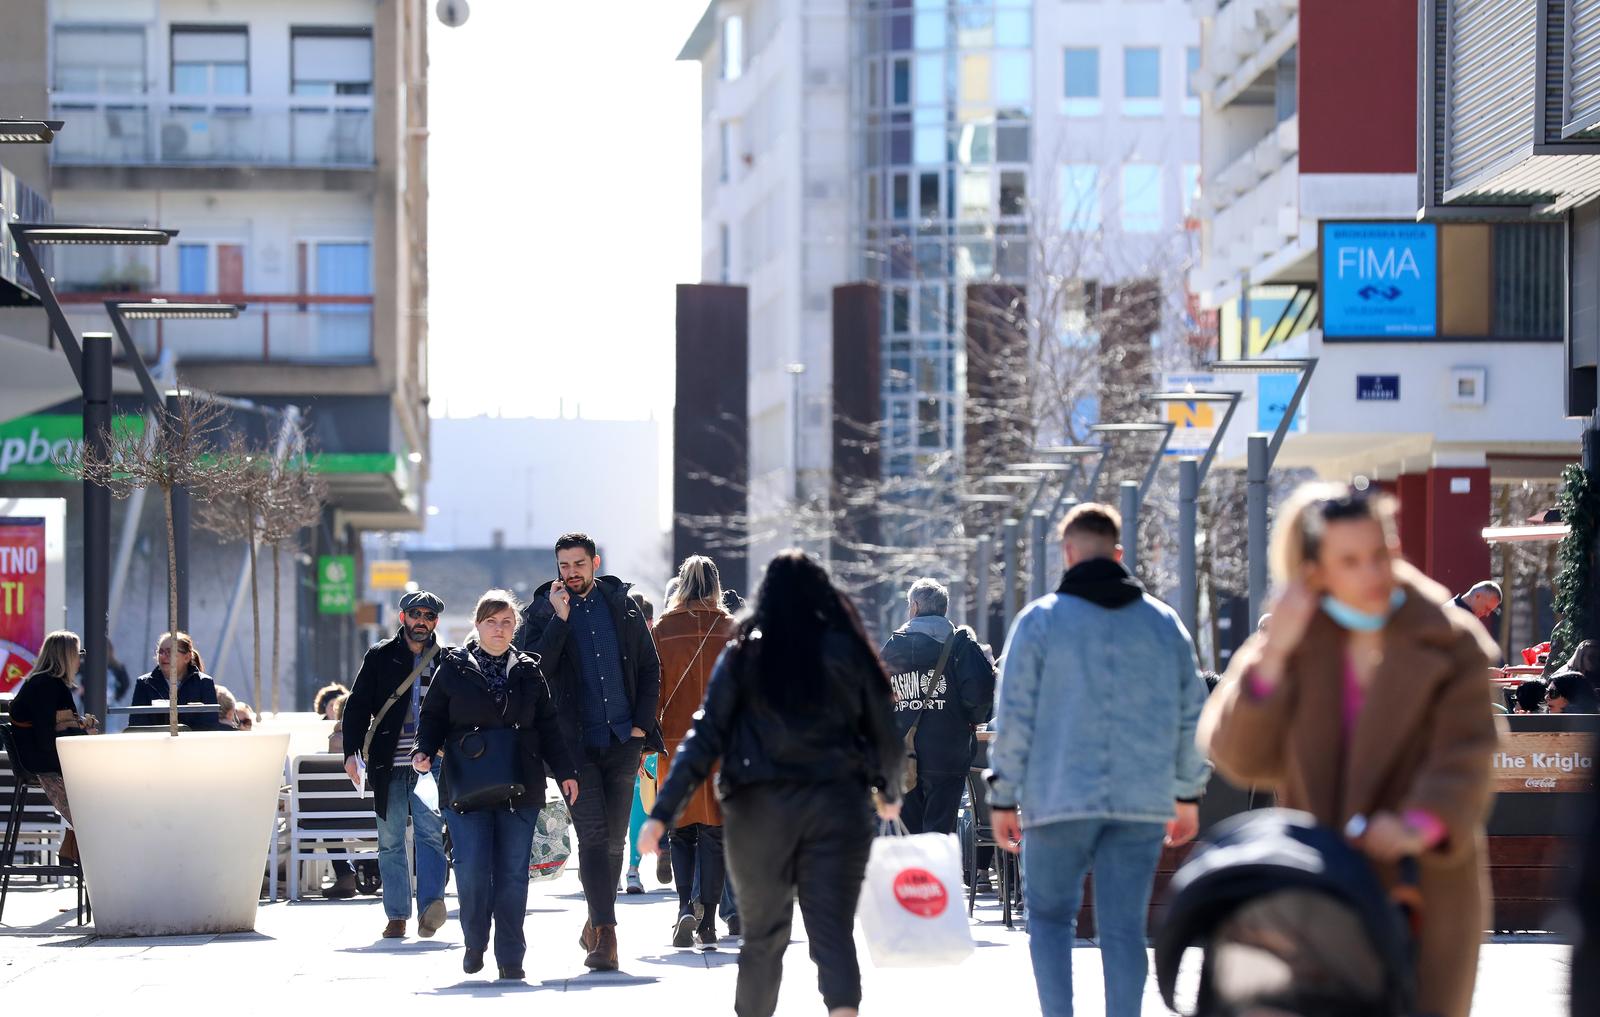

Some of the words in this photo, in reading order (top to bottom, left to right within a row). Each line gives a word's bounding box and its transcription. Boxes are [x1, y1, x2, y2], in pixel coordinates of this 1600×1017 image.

[1338, 246, 1421, 280] FIMA
[0, 546, 38, 575] TNO
[1493, 752, 1526, 769] The
[1530, 752, 1592, 773] Krigla
